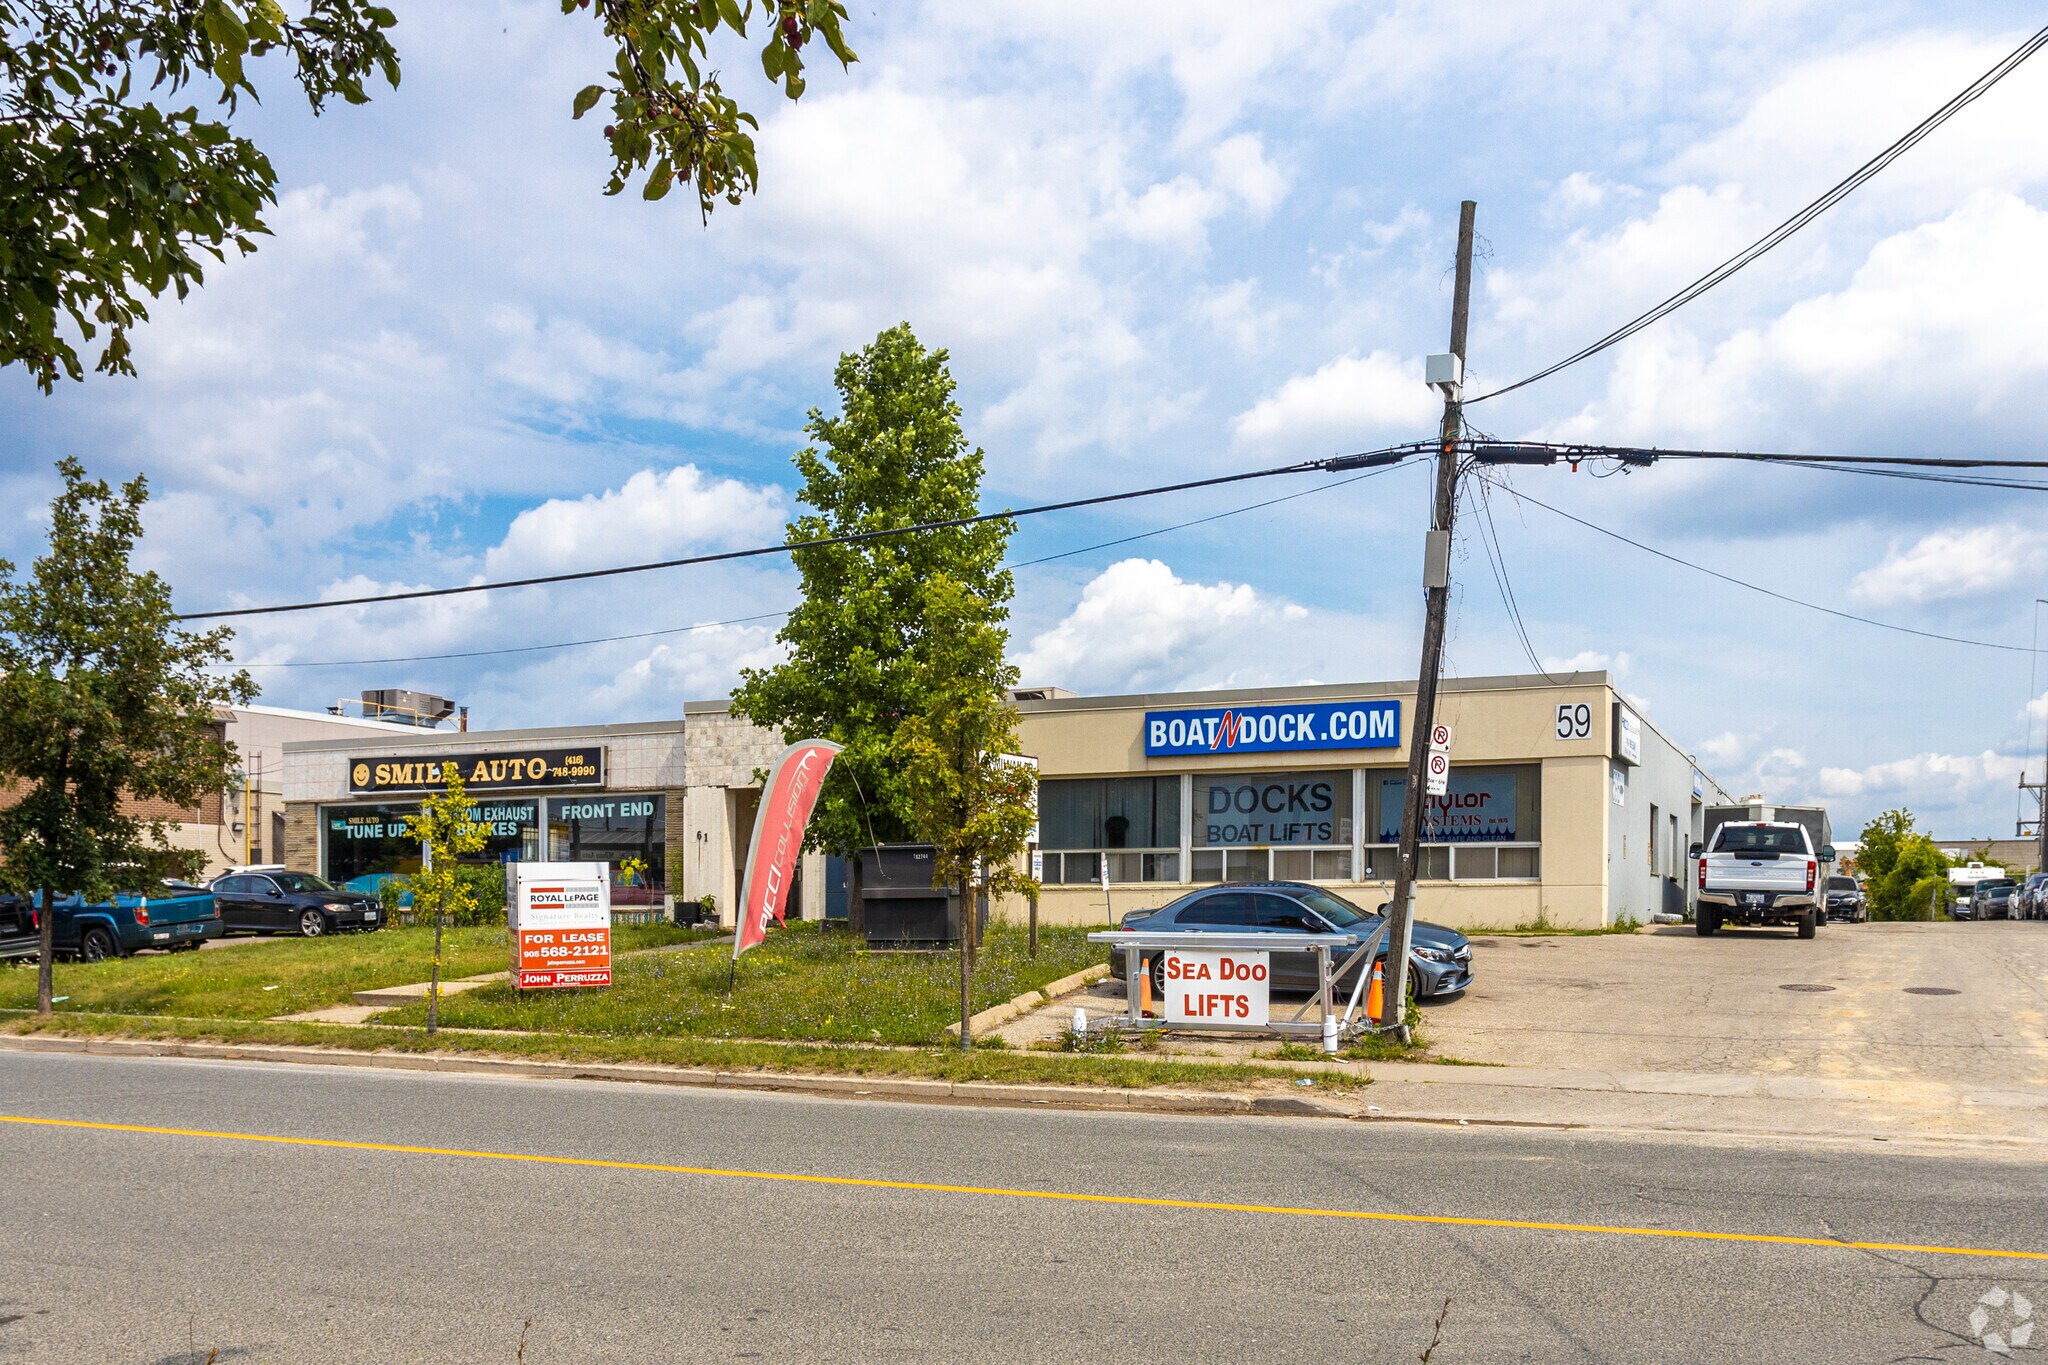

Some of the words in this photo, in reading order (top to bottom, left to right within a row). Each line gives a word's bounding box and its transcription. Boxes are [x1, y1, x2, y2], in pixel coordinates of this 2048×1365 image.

[1557, 703, 1591, 738] 59
[565, 755, 583, 765] (416)
[469, 757, 547, 782] AUTO
[553, 766, 595, 777] 748-9990
[1208, 783, 1332, 815] DOCKS
[484, 806, 533, 820] EXHAUST
[562, 804, 615, 820] FRONT
[620, 801, 653, 817] END
[365, 816, 379, 824] AUTO
[1423, 814, 1481, 827] YSTEMS
[346, 824, 383, 839] TUNE
[387, 823, 407, 837] UP
[697, 830, 708, 843] 61
[1207, 824, 1264, 843] BOAT
[1269, 822, 1332, 842] LIFTS
[1447, 834, 1465, 842] SAFE
[1482, 833, 1506, 841] CLEAN
[759, 864, 782, 934] PICCI
[774, 769, 808, 868] COLLISION
[530, 912, 571, 922] Signature
[574, 911, 599, 920] Realty
[525, 934, 554, 944] FOR
[562, 933, 605, 942] LEASE
[523, 950, 540, 958] 905
[540, 945, 608, 957] 568-2121
[1184, 994, 1249, 1018] LIFTS
